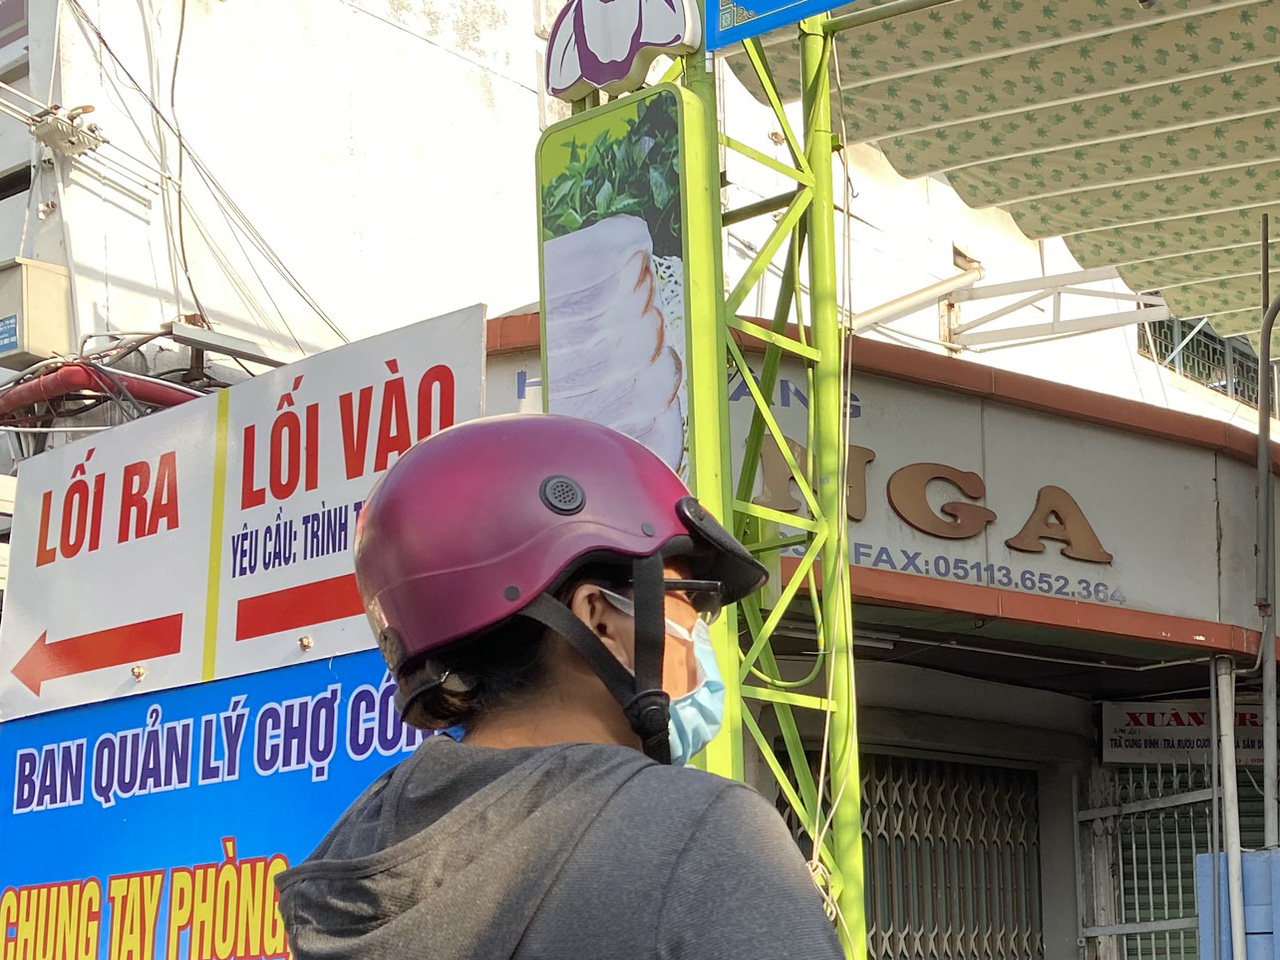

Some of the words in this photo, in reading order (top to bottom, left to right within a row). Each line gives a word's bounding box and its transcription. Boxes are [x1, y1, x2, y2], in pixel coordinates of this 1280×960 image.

[241, 375, 320, 510] LỐI
[36, 448, 105, 567] LỐI
[117, 451, 179, 544] RA
[231, 523, 257, 578] YÊU
[263, 506, 297, 571] CẦU:
[302, 501, 348, 561] TRÌNH
[14, 738, 87, 813] BAN
[93, 705, 190, 806] QUẢN
[199, 697, 248, 783] LÝ
[256, 685, 340, 781] CHỢ
